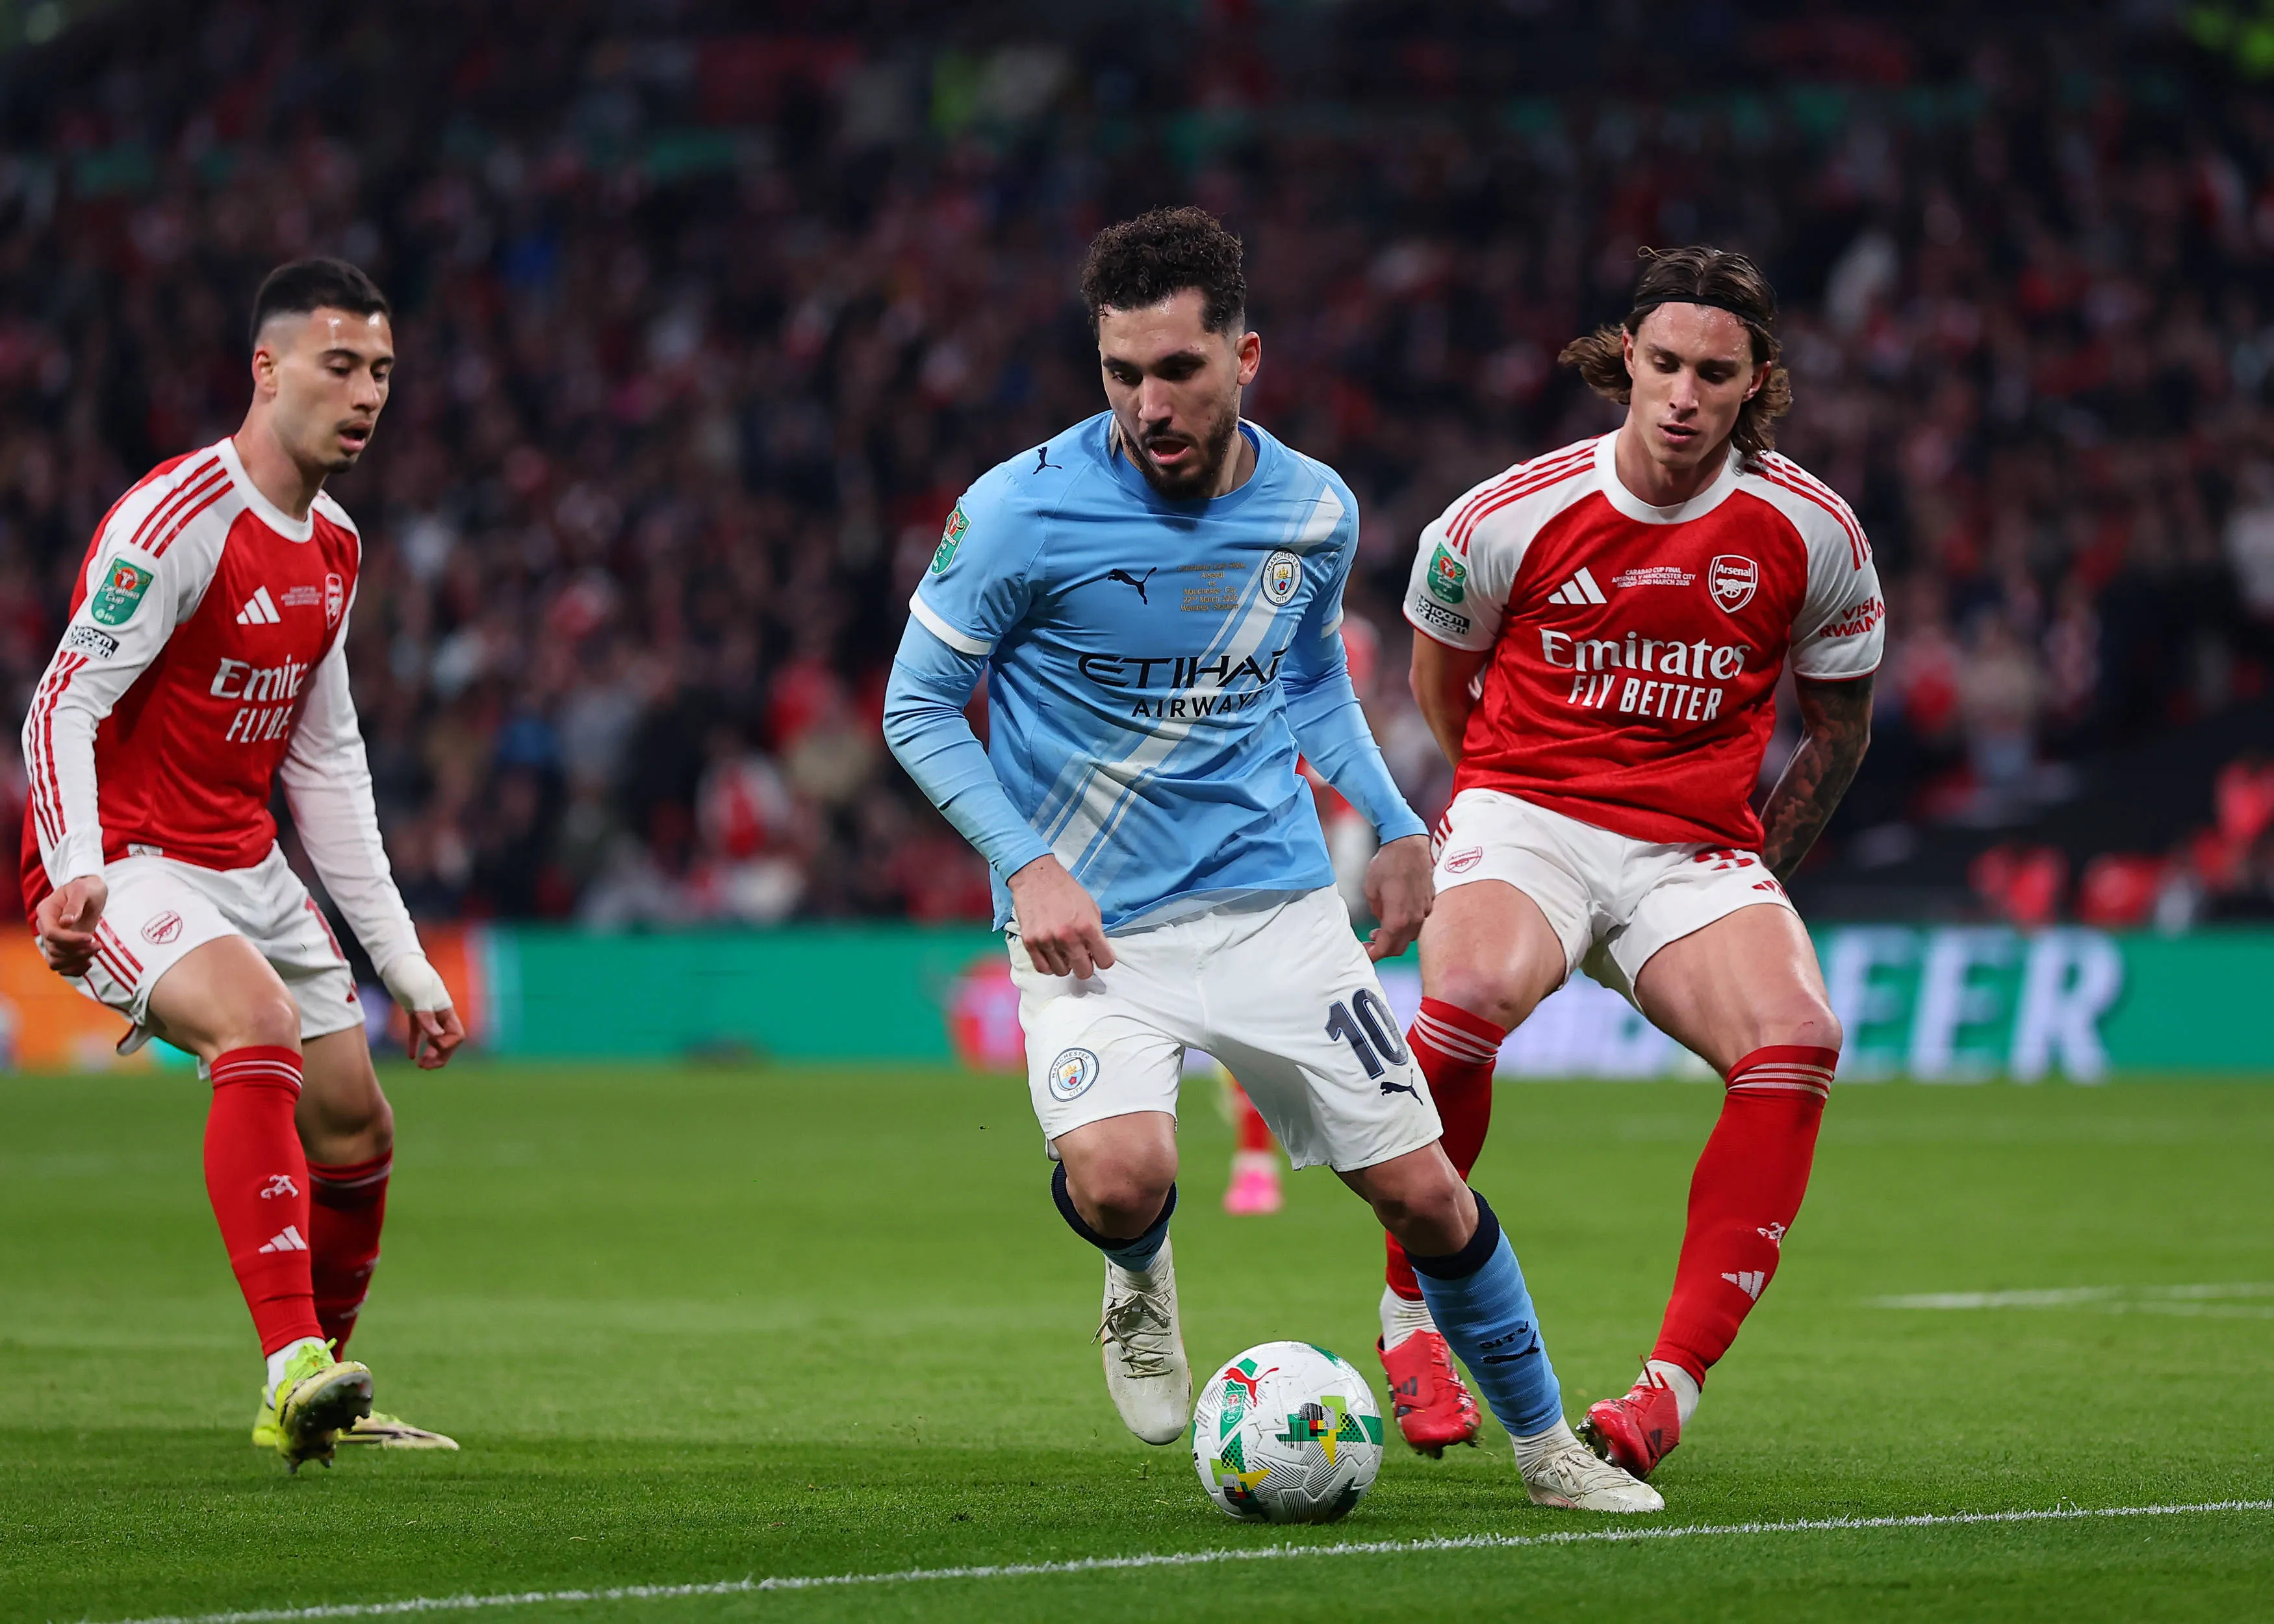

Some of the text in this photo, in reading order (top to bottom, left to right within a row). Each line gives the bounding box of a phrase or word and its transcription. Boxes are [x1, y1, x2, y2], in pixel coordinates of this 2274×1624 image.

[1267, 552, 1299, 572] MANCHESTER
[1717, 564, 1752, 577] Arsenal
[1841, 594, 1876, 621] VISI
[1539, 628, 1751, 679] Emirates
[1131, 690, 1262, 718] AIRWAY
[1567, 674, 1722, 721] FLY BETTER
[225, 706, 271, 743] FLY
[1324, 988, 1408, 1080] 10
[1052, 1052, 1090, 1078] MANCHESTER
[1069, 1086, 1083, 1097] CITY
